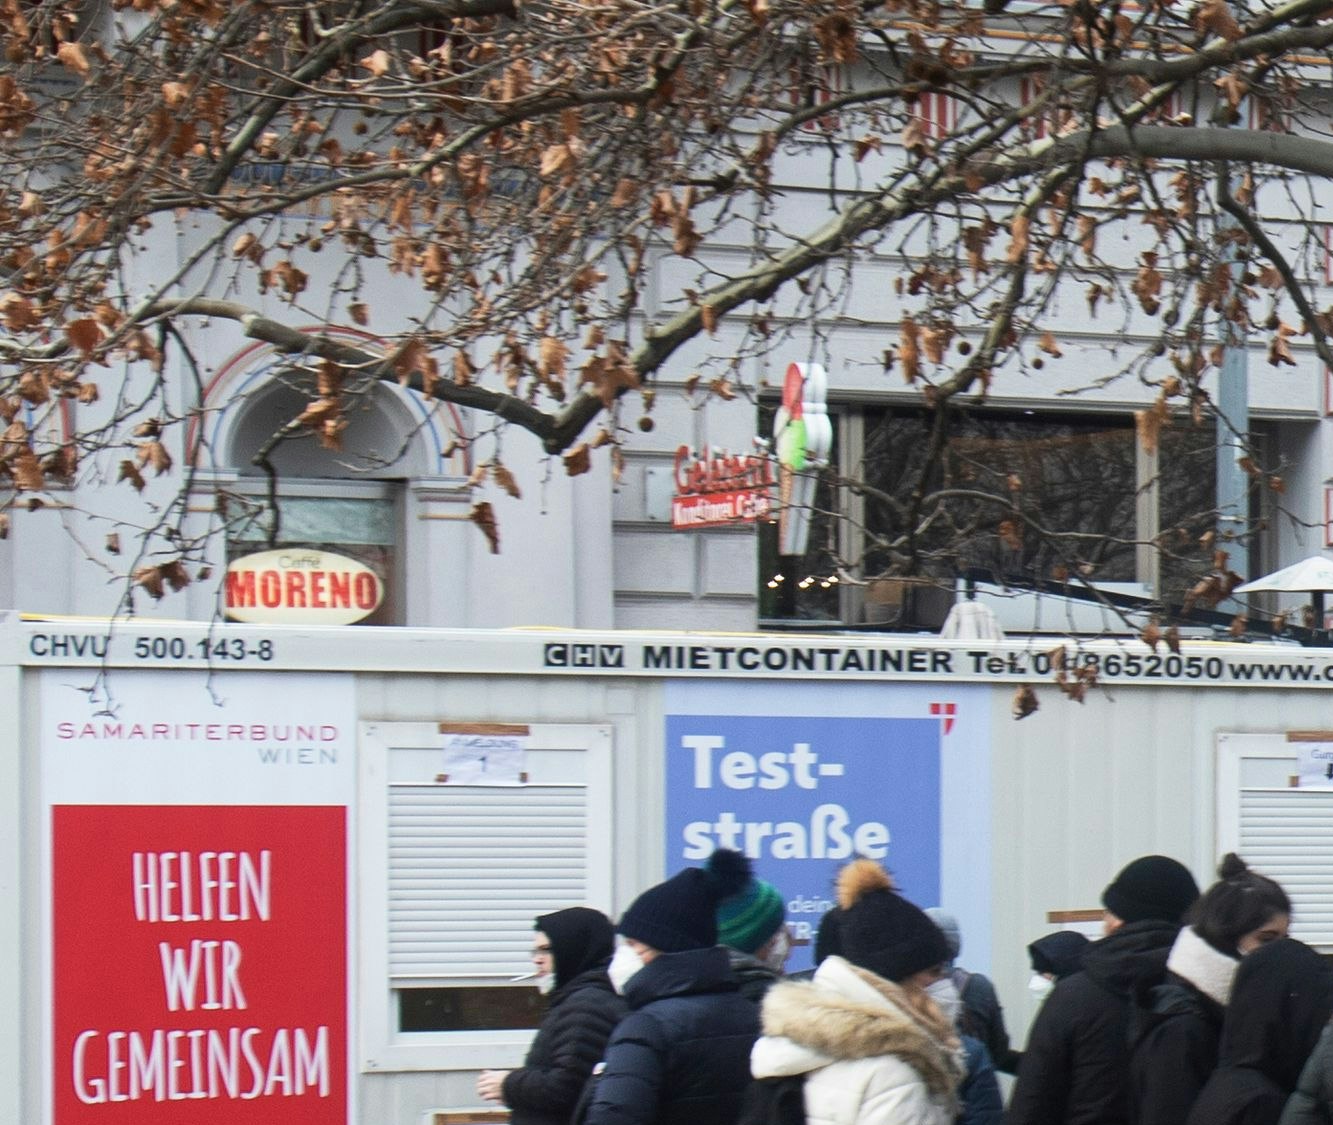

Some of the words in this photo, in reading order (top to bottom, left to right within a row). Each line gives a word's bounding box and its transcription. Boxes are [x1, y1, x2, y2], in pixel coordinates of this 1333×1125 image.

[224, 570, 377, 611] MORENO
[29, 634, 109, 658] CHVU
[134, 636, 275, 661] 500.143-8
[544, 643, 625, 668] CHV
[642, 645, 953, 673] MIETCONTAINER
[56, 721, 339, 743] SAMARITERBUND
[257, 748, 338, 765] WIEN
[681, 735, 845, 790] Test-
[682, 803, 892, 860] straße
[132, 850, 272, 923] HELFEN
[159, 939, 247, 1012] WIR
[72, 1025, 331, 1105] GEMEINSAM
